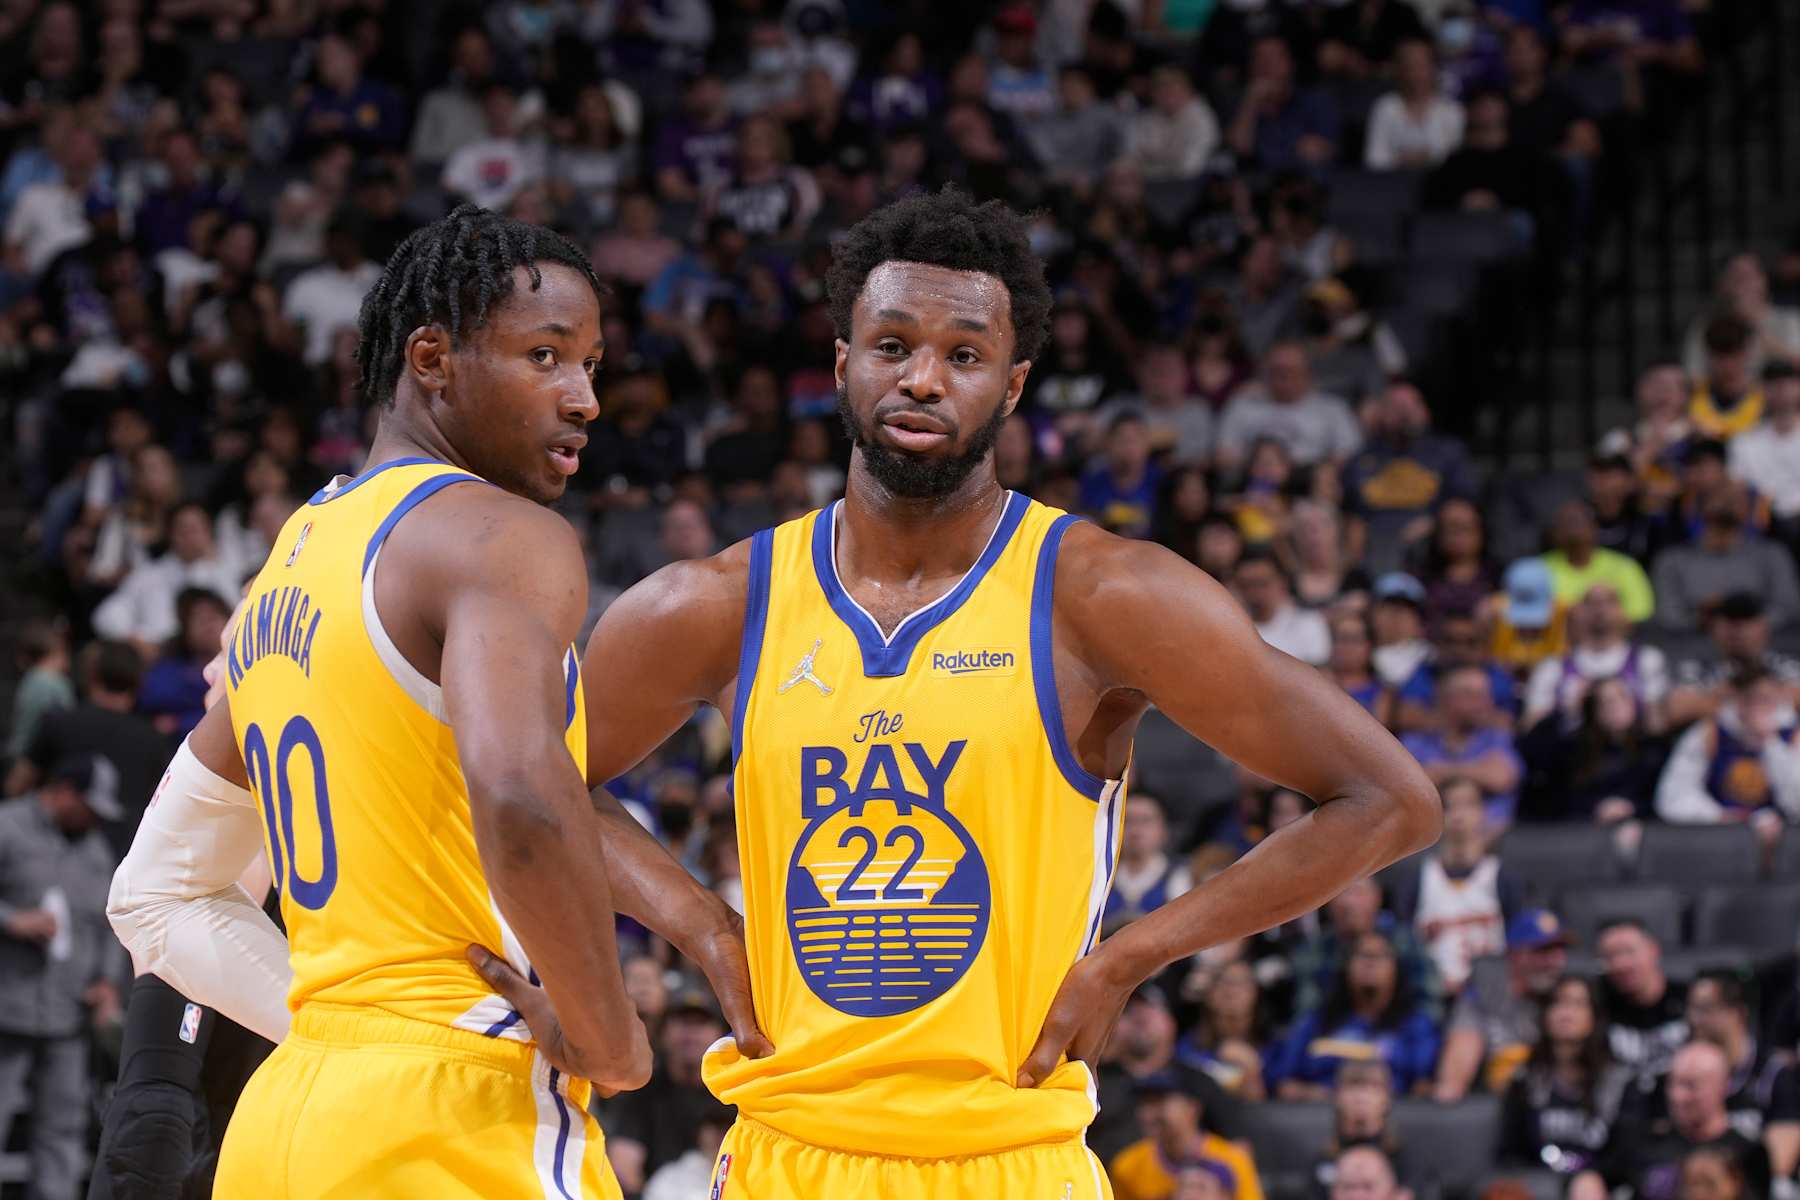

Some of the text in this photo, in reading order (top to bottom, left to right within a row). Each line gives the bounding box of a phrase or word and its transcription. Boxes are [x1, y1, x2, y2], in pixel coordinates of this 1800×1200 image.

[228, 586, 322, 692] KUMINGA
[933, 650, 1014, 670] Rakuten
[853, 709, 903, 743] The
[801, 738, 968, 819] BAY
[836, 824, 926, 901] 22
